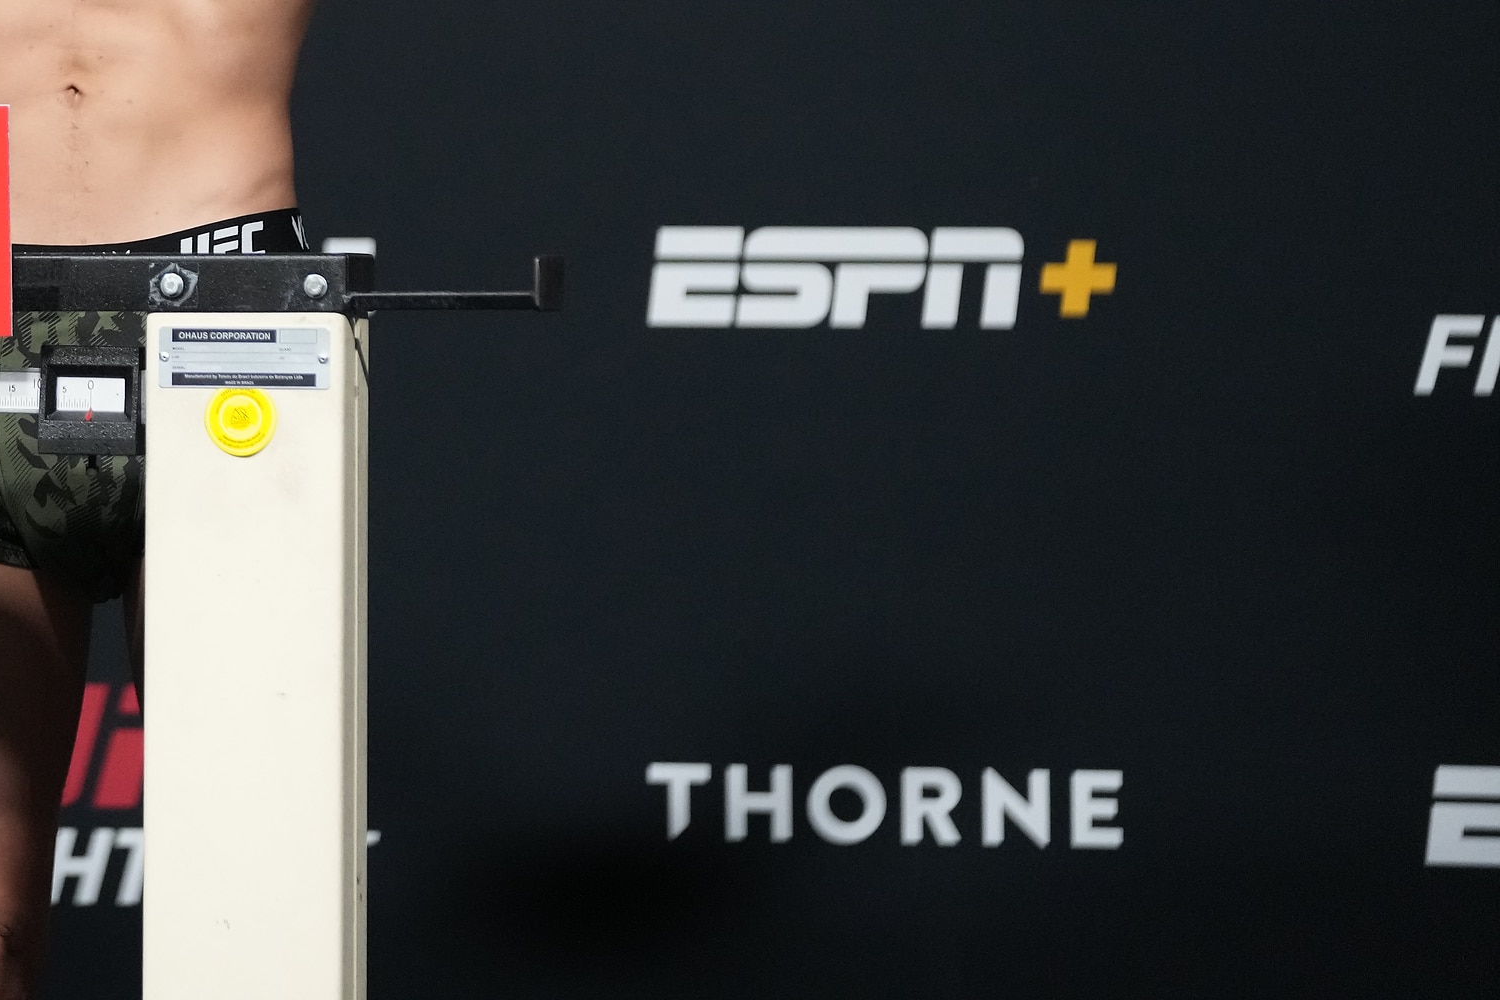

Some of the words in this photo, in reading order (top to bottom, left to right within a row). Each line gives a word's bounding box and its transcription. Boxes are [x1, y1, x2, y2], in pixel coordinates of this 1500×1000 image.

[178, 331, 208, 340] OHAUS
[210, 331, 271, 341] CORPORATION
[8, 385, 17, 393] 15
[87, 380, 95, 390] 0
[645, 761, 1124, 850] THORNE
